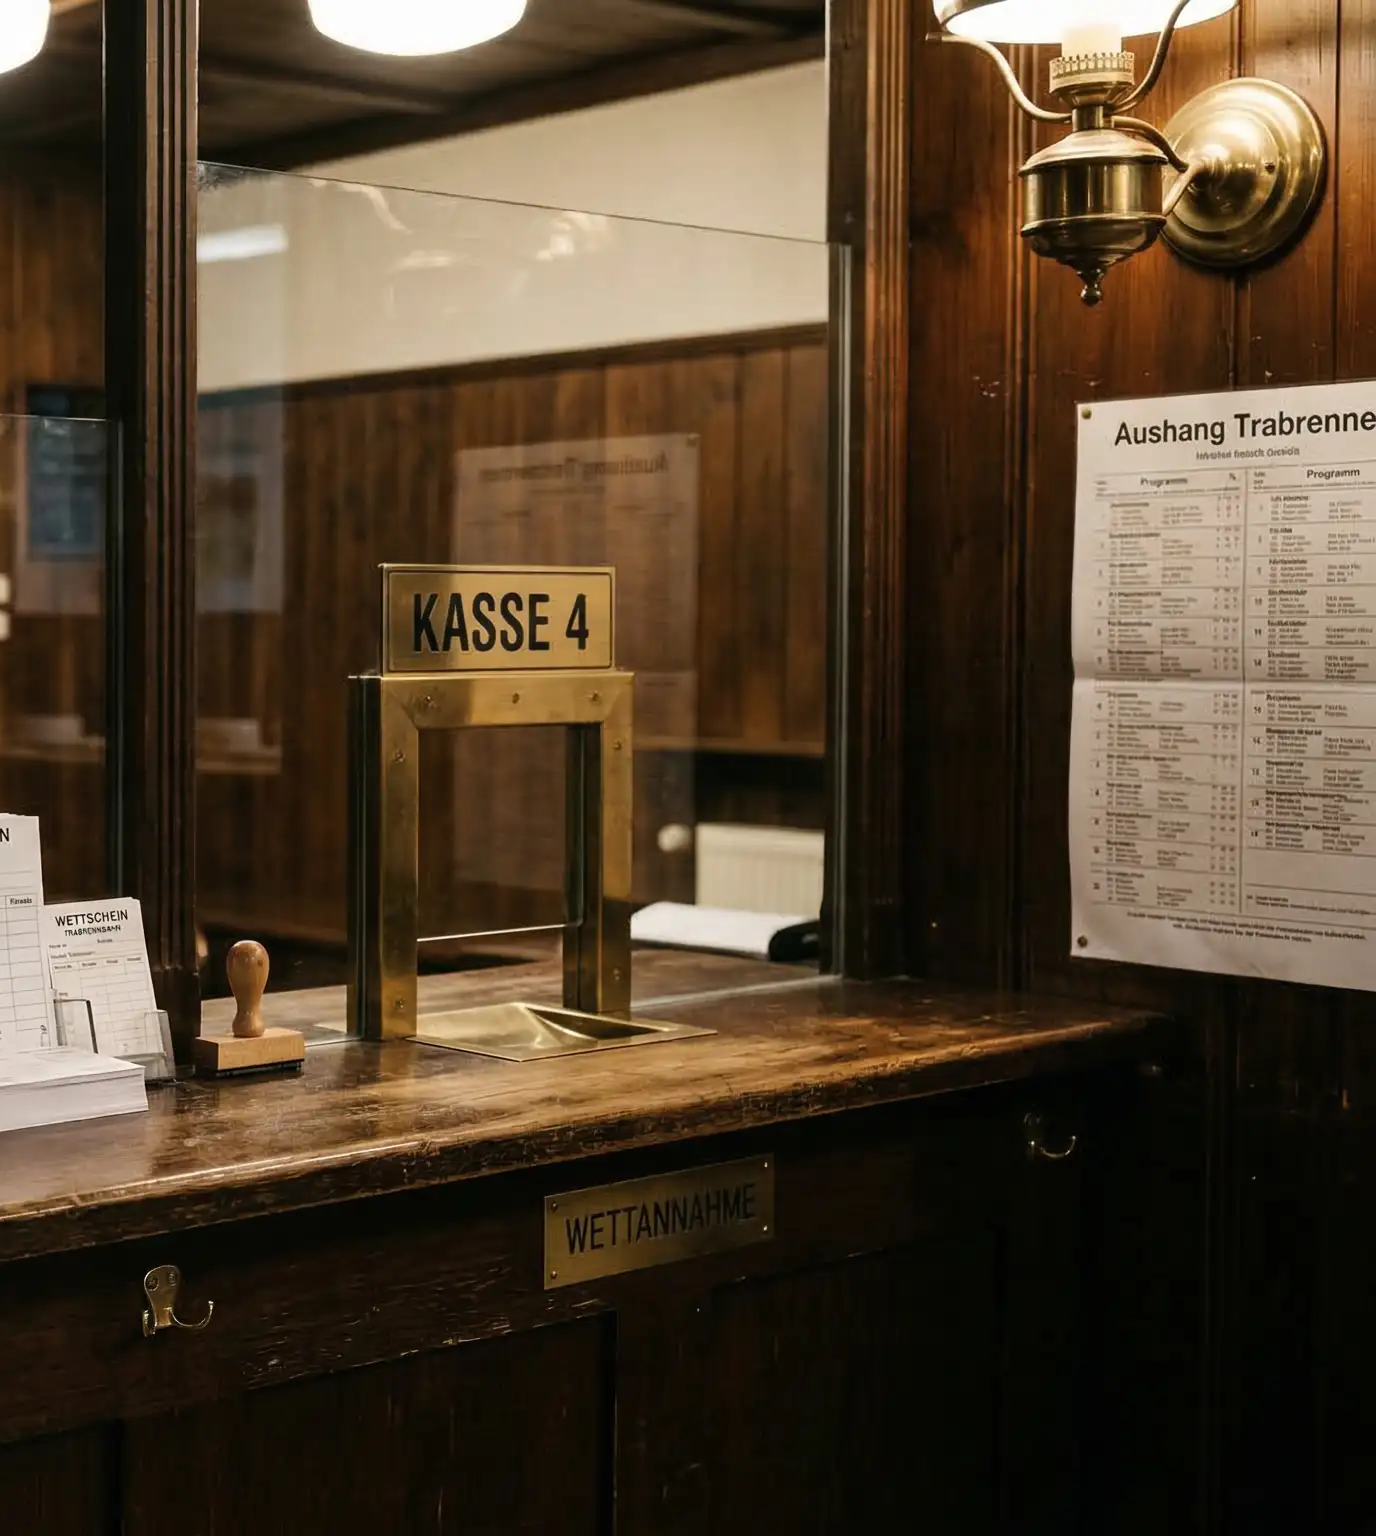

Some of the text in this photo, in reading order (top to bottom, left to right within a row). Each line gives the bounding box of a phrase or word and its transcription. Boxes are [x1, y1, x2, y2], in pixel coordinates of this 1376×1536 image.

[1114, 410, 1376, 446] Aushang Trabrenne
[1306, 467, 1360, 479] Programm
[413, 592, 590, 652] KASSE 4
[55, 909, 128, 927] WETTSCHEIN
[565, 1183, 756, 1254] WETTANNAHME
